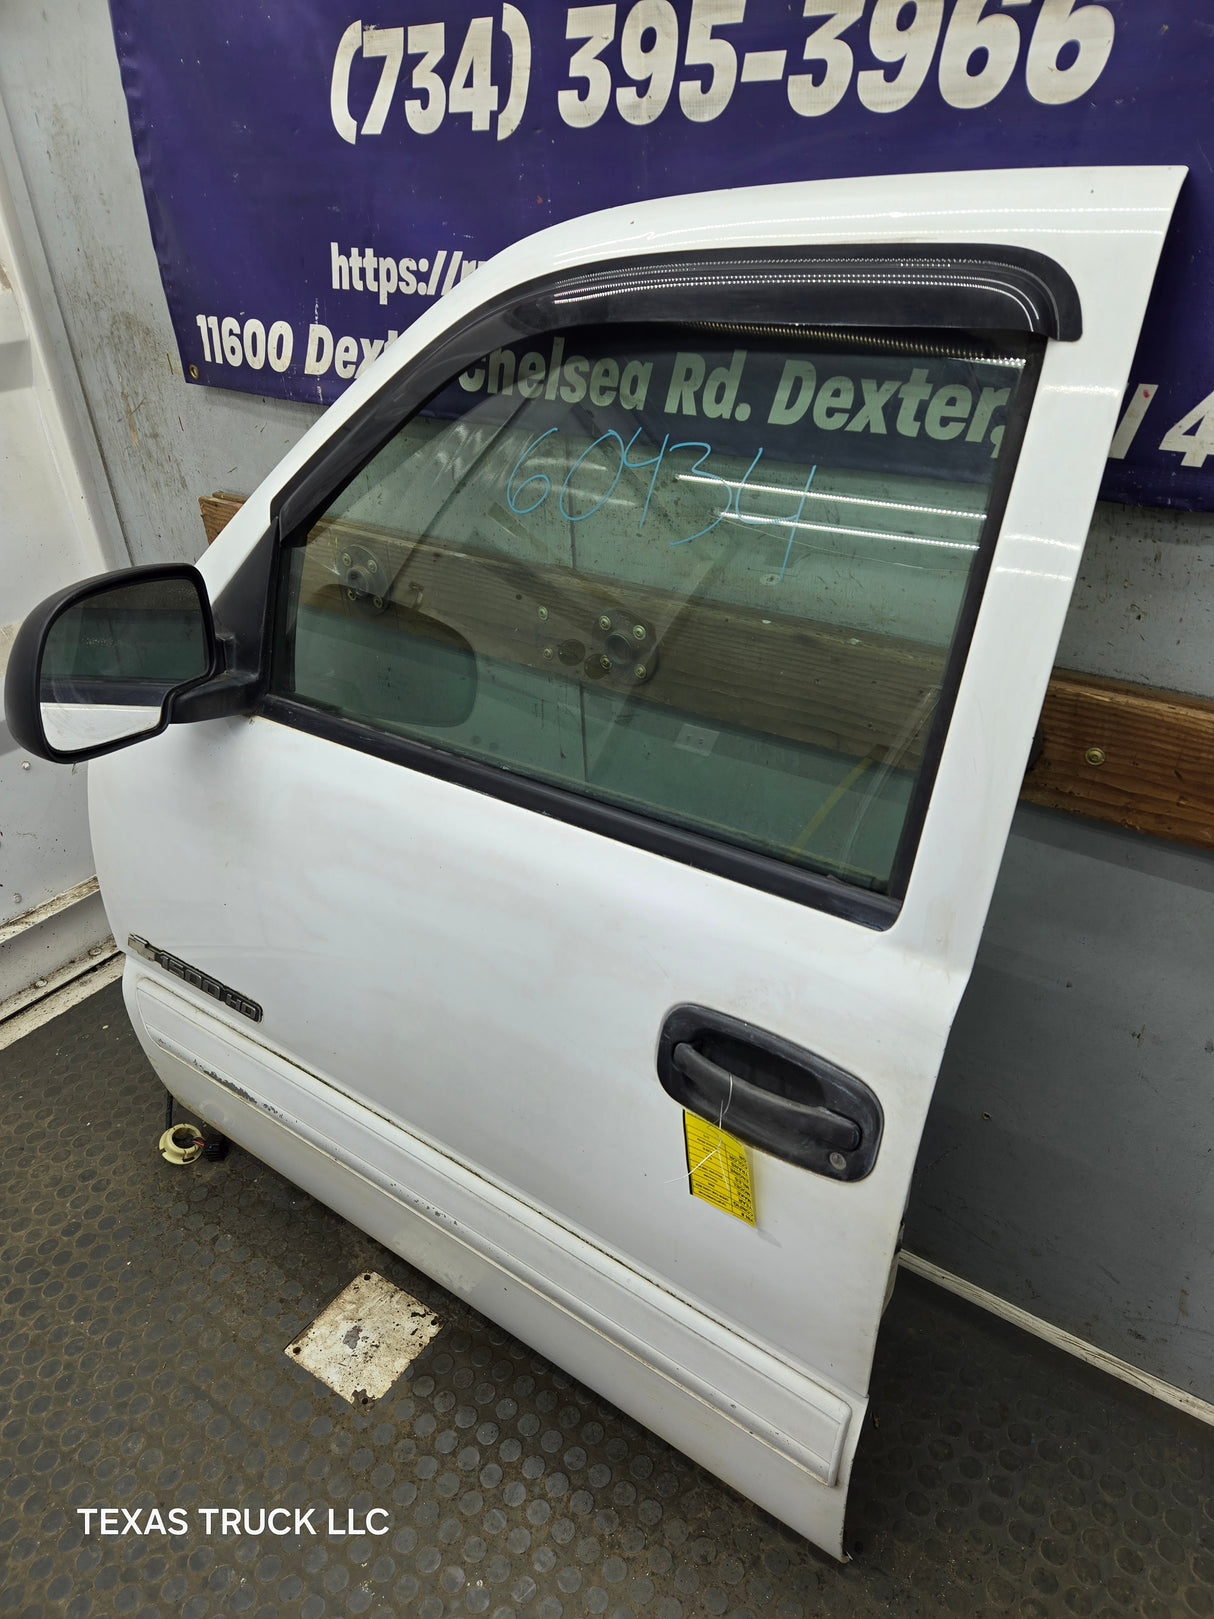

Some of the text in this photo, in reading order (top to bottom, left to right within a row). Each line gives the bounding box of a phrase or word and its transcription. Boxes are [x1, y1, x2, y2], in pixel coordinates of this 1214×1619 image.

[330, 0, 1116, 145] (734) 395-3966
[330, 241, 489, 306] https://r
[195, 313, 294, 373] 11600
[663, 349, 751, 422] Rd.
[1157, 390, 1214, 468] 4
[160, 954, 221, 1001] 1500
